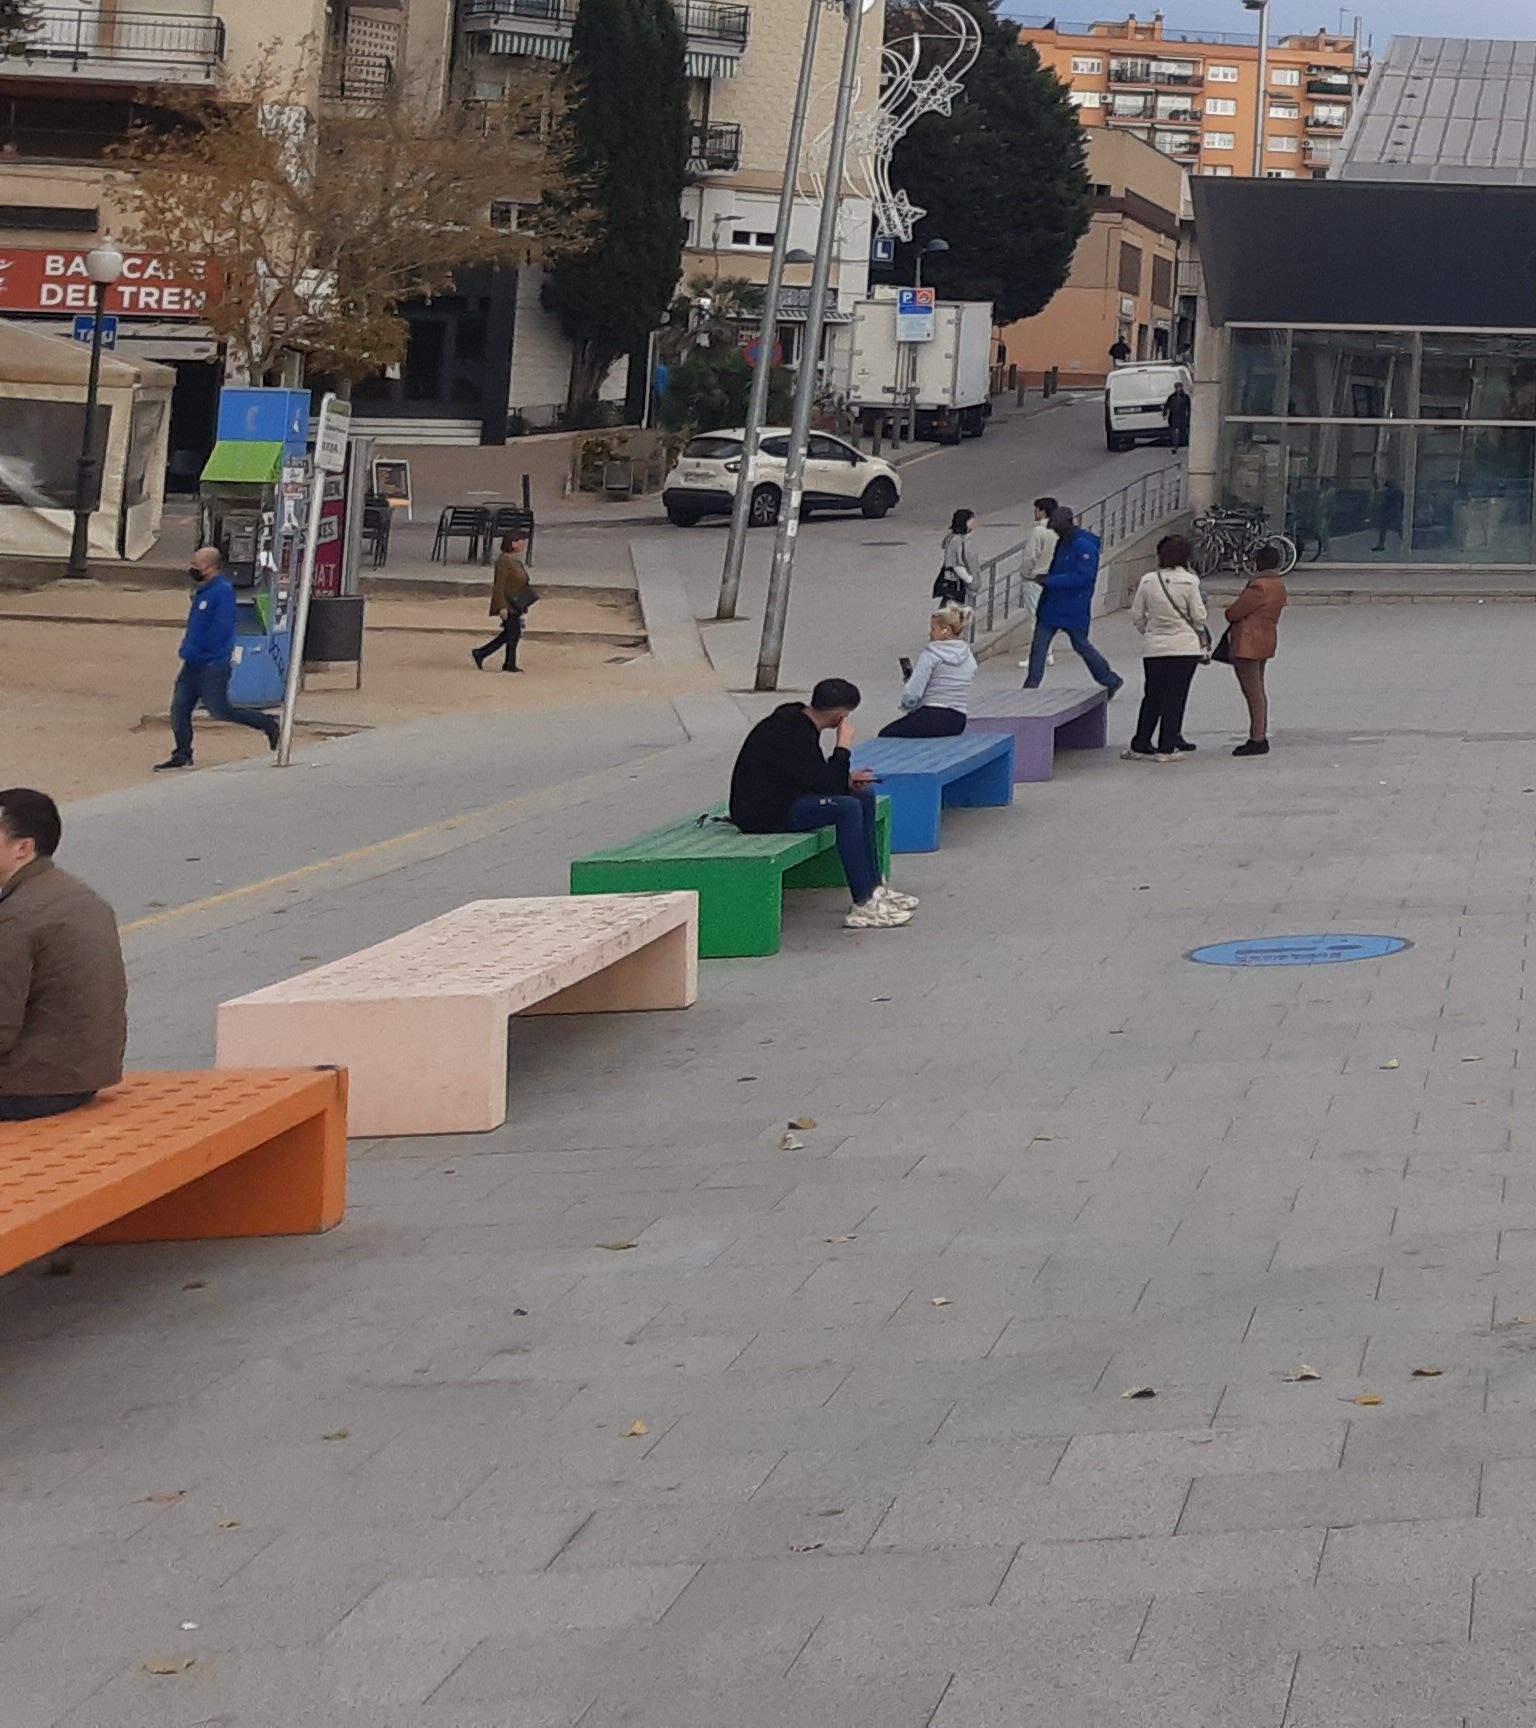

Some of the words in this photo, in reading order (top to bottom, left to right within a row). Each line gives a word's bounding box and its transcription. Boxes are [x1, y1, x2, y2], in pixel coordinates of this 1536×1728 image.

[876, 242, 889, 258] L
[45, 255, 108, 277] BA
[40, 283, 98, 307] DEL
[117, 286, 206, 310] TREN
